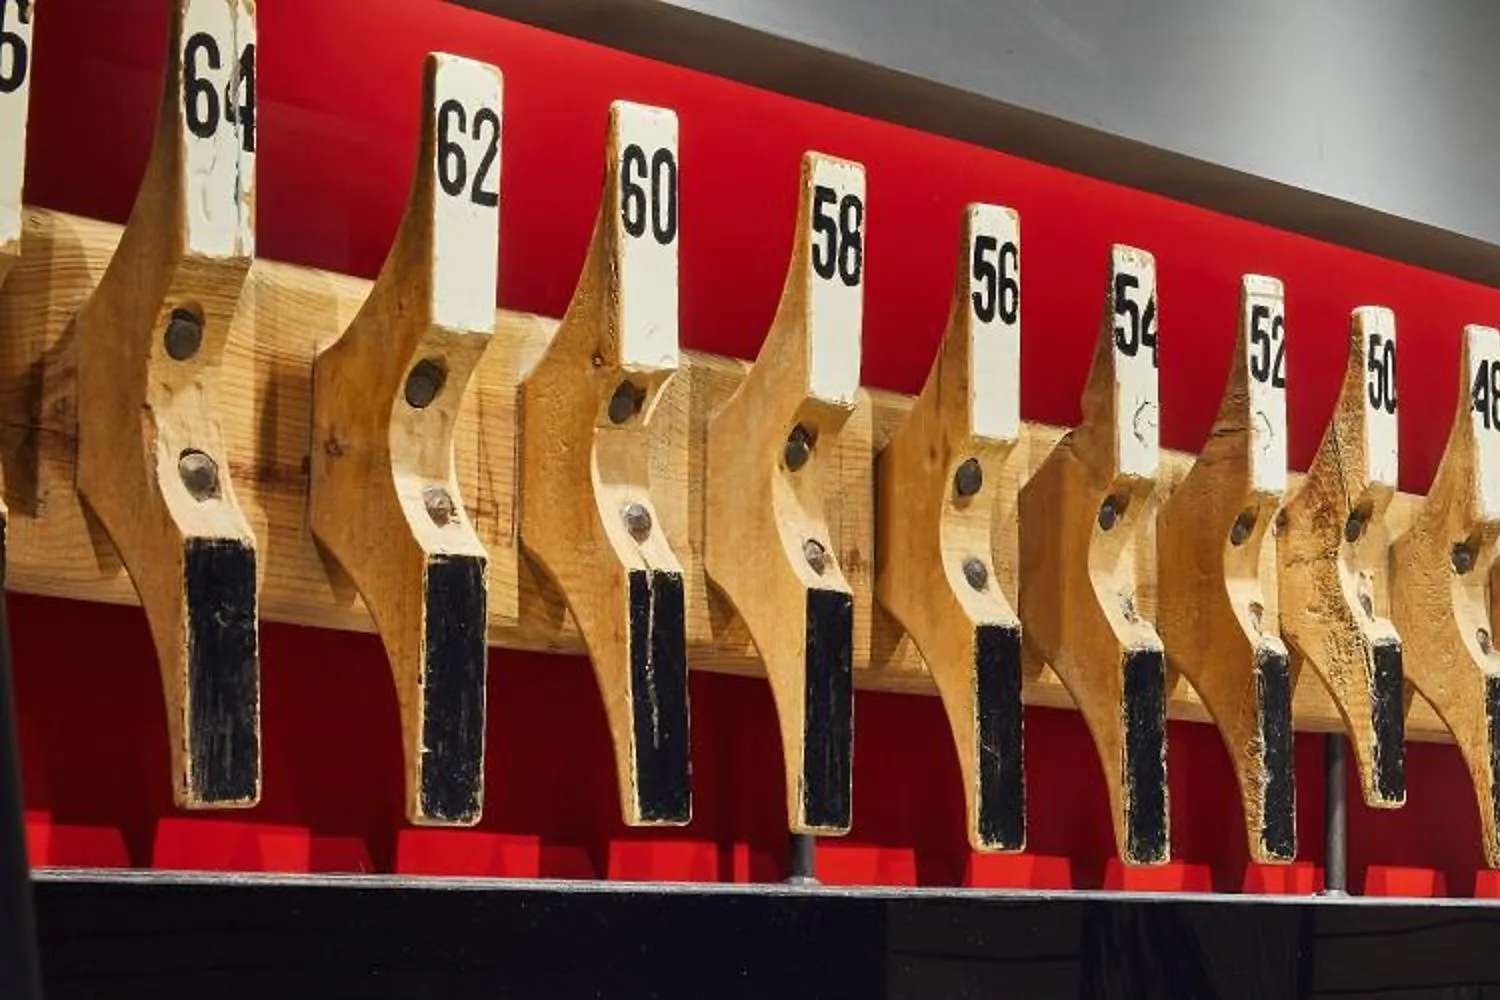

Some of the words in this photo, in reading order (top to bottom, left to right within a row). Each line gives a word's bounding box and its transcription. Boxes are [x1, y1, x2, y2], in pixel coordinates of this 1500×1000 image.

[183, 32, 256, 152] 64
[437, 99, 500, 207] 62
[621, 144, 677, 245] 60
[811, 186, 864, 286] 58
[971, 236, 1019, 325] 56
[1114, 273, 1158, 368] 54
[1250, 305, 1285, 388] 52
[1367, 333, 1397, 415] 50
